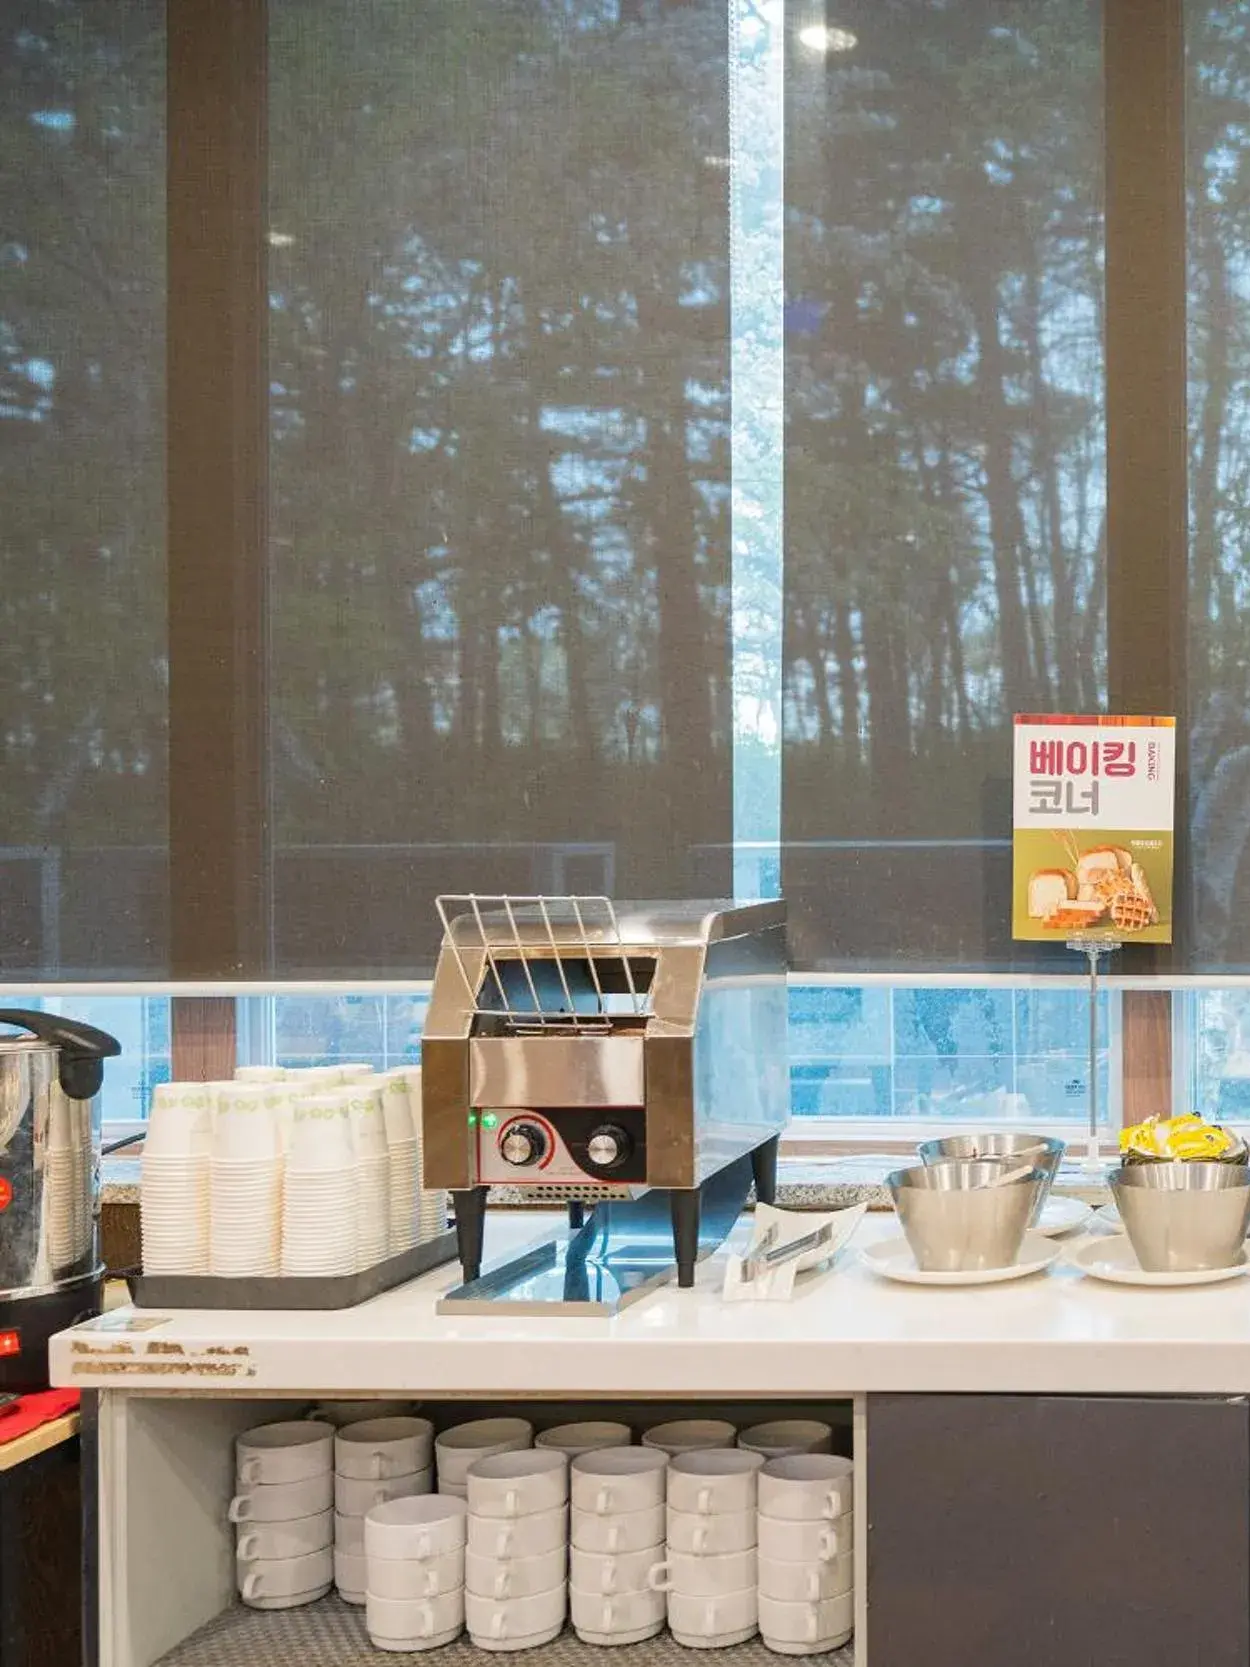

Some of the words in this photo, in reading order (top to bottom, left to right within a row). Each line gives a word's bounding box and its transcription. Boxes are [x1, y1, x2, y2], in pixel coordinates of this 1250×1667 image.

[1030, 740, 1136, 777] 베이킹
[1147, 741, 1156, 781] BAKING
[1029, 780, 1099, 816] 코너
